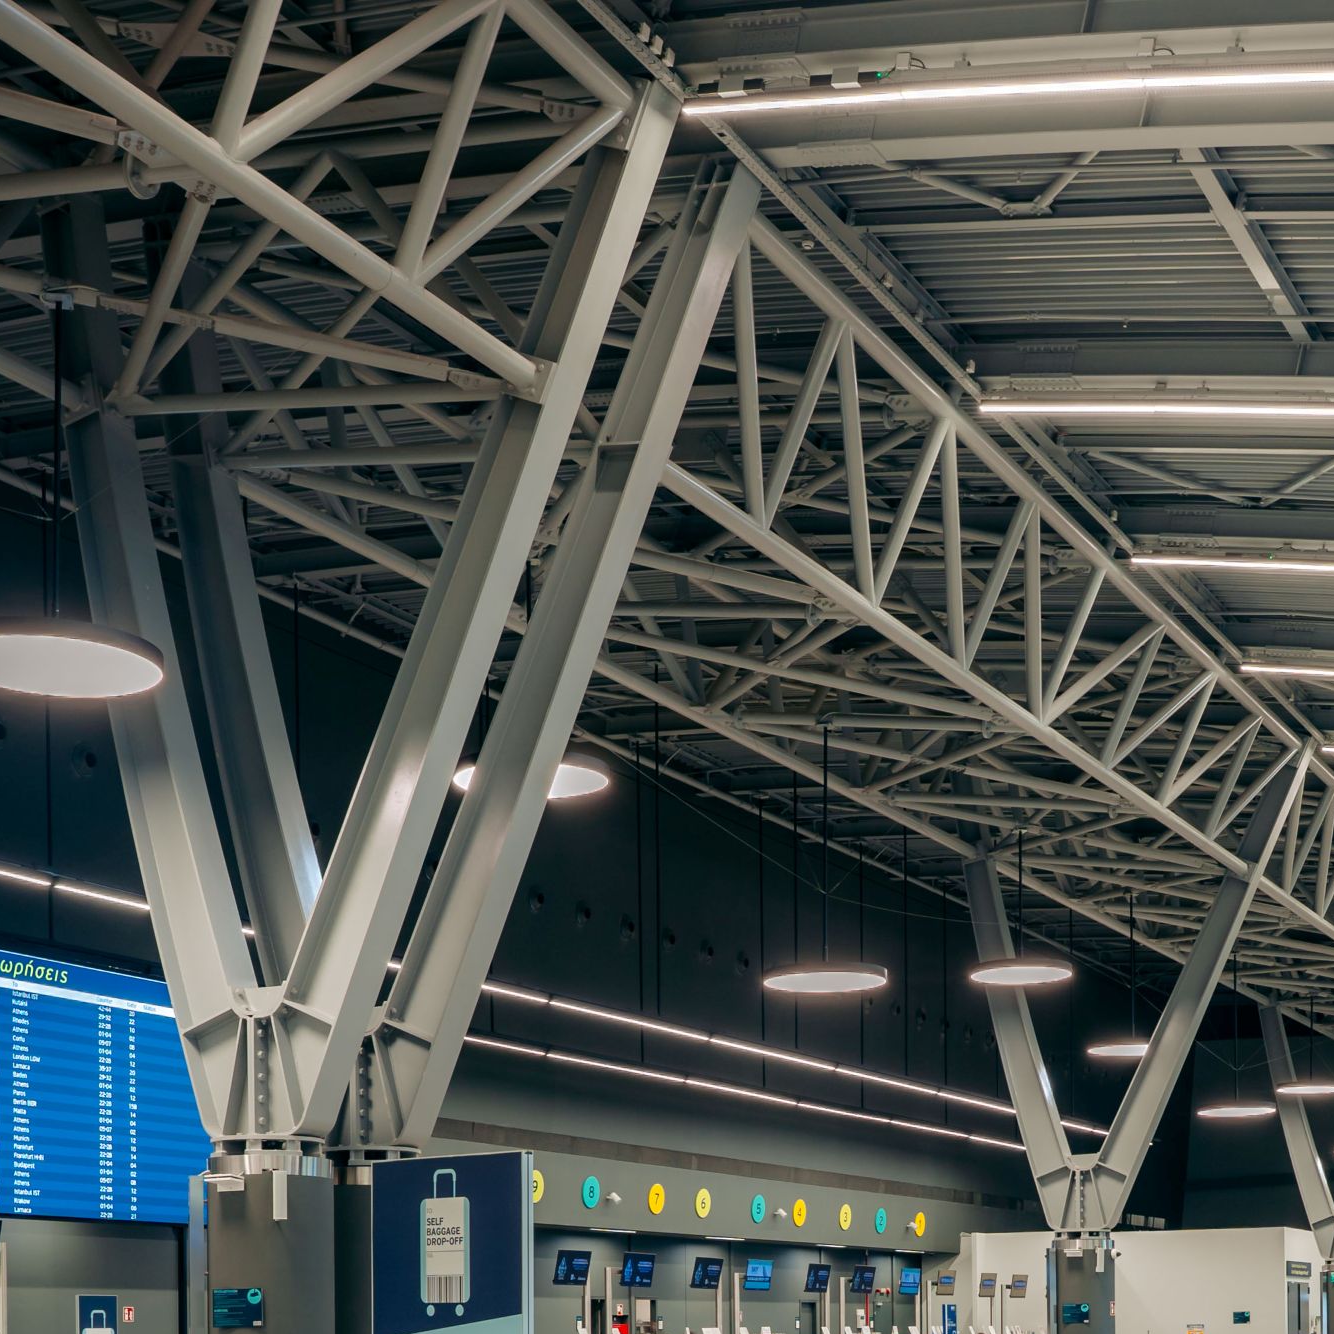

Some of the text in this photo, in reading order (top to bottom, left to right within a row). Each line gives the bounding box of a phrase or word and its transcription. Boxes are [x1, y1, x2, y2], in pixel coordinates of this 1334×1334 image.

[588, 1185, 595, 1198] 8
[655, 1193, 660, 1205] 7
[701, 1197, 706, 1209] 6
[756, 1203, 761, 1215] 5
[427, 1217, 444, 1226] SELF
[843, 1212, 848, 1222] 3
[879, 1216, 884, 1226] 2
[427, 1227, 461, 1236] BAGGAGE
[427, 1236, 464, 1246] DROP-OFF
